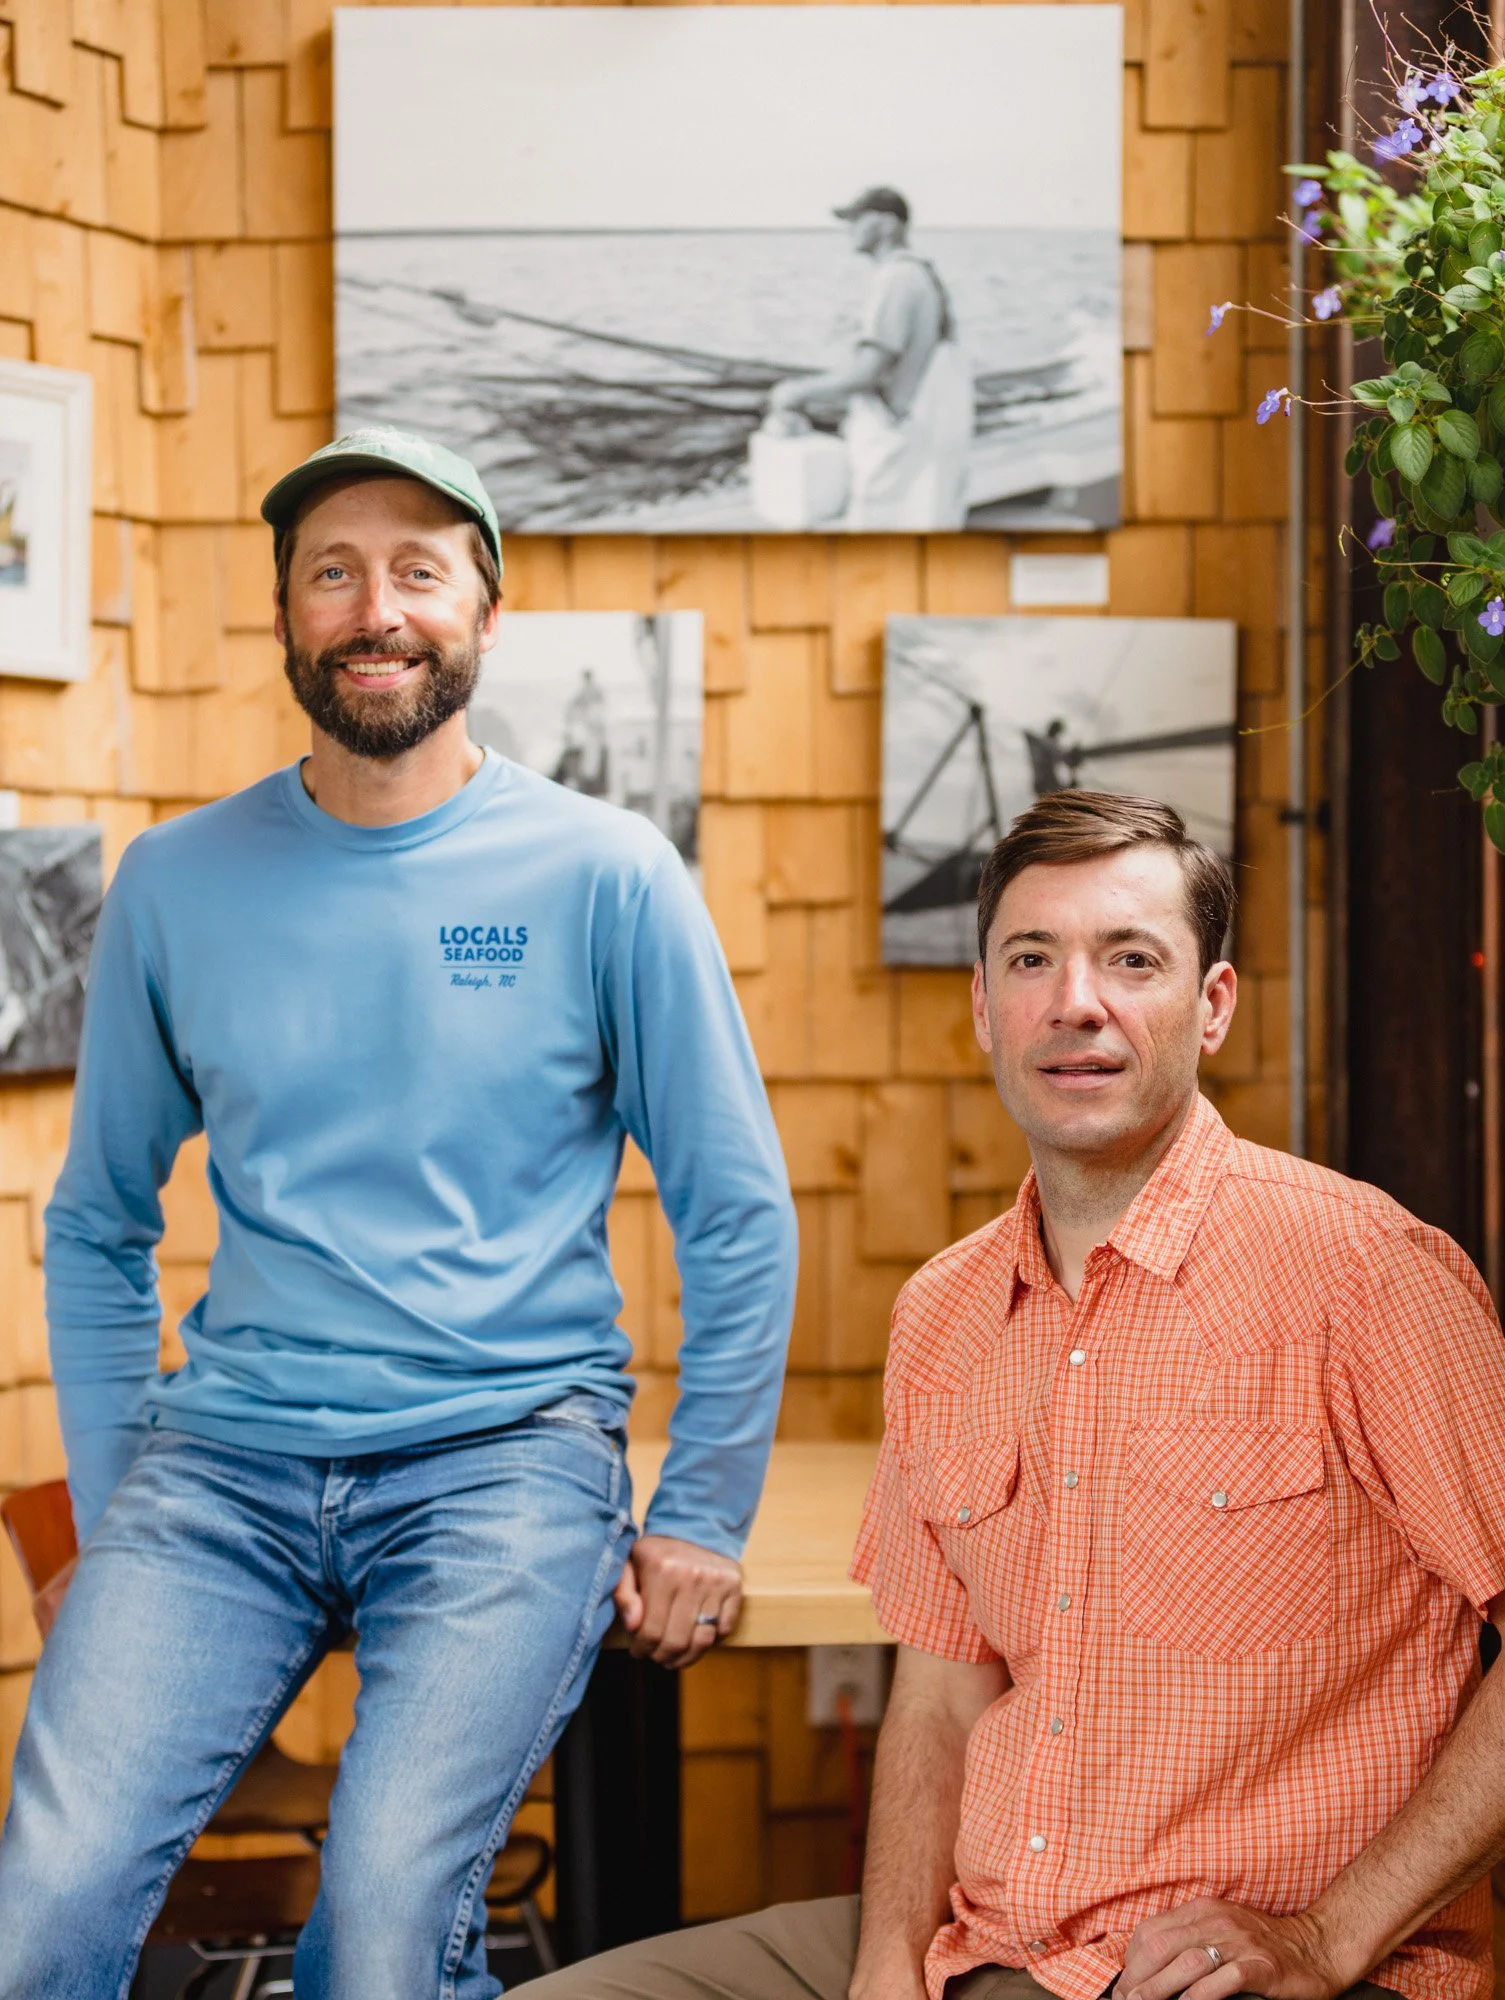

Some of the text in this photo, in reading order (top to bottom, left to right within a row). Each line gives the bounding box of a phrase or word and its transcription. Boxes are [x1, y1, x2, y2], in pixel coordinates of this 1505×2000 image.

[440, 926, 528, 946] LOCALS
[444, 947, 524, 962] SEAFOOD
[450, 973, 517, 991] Raleigh, NC
